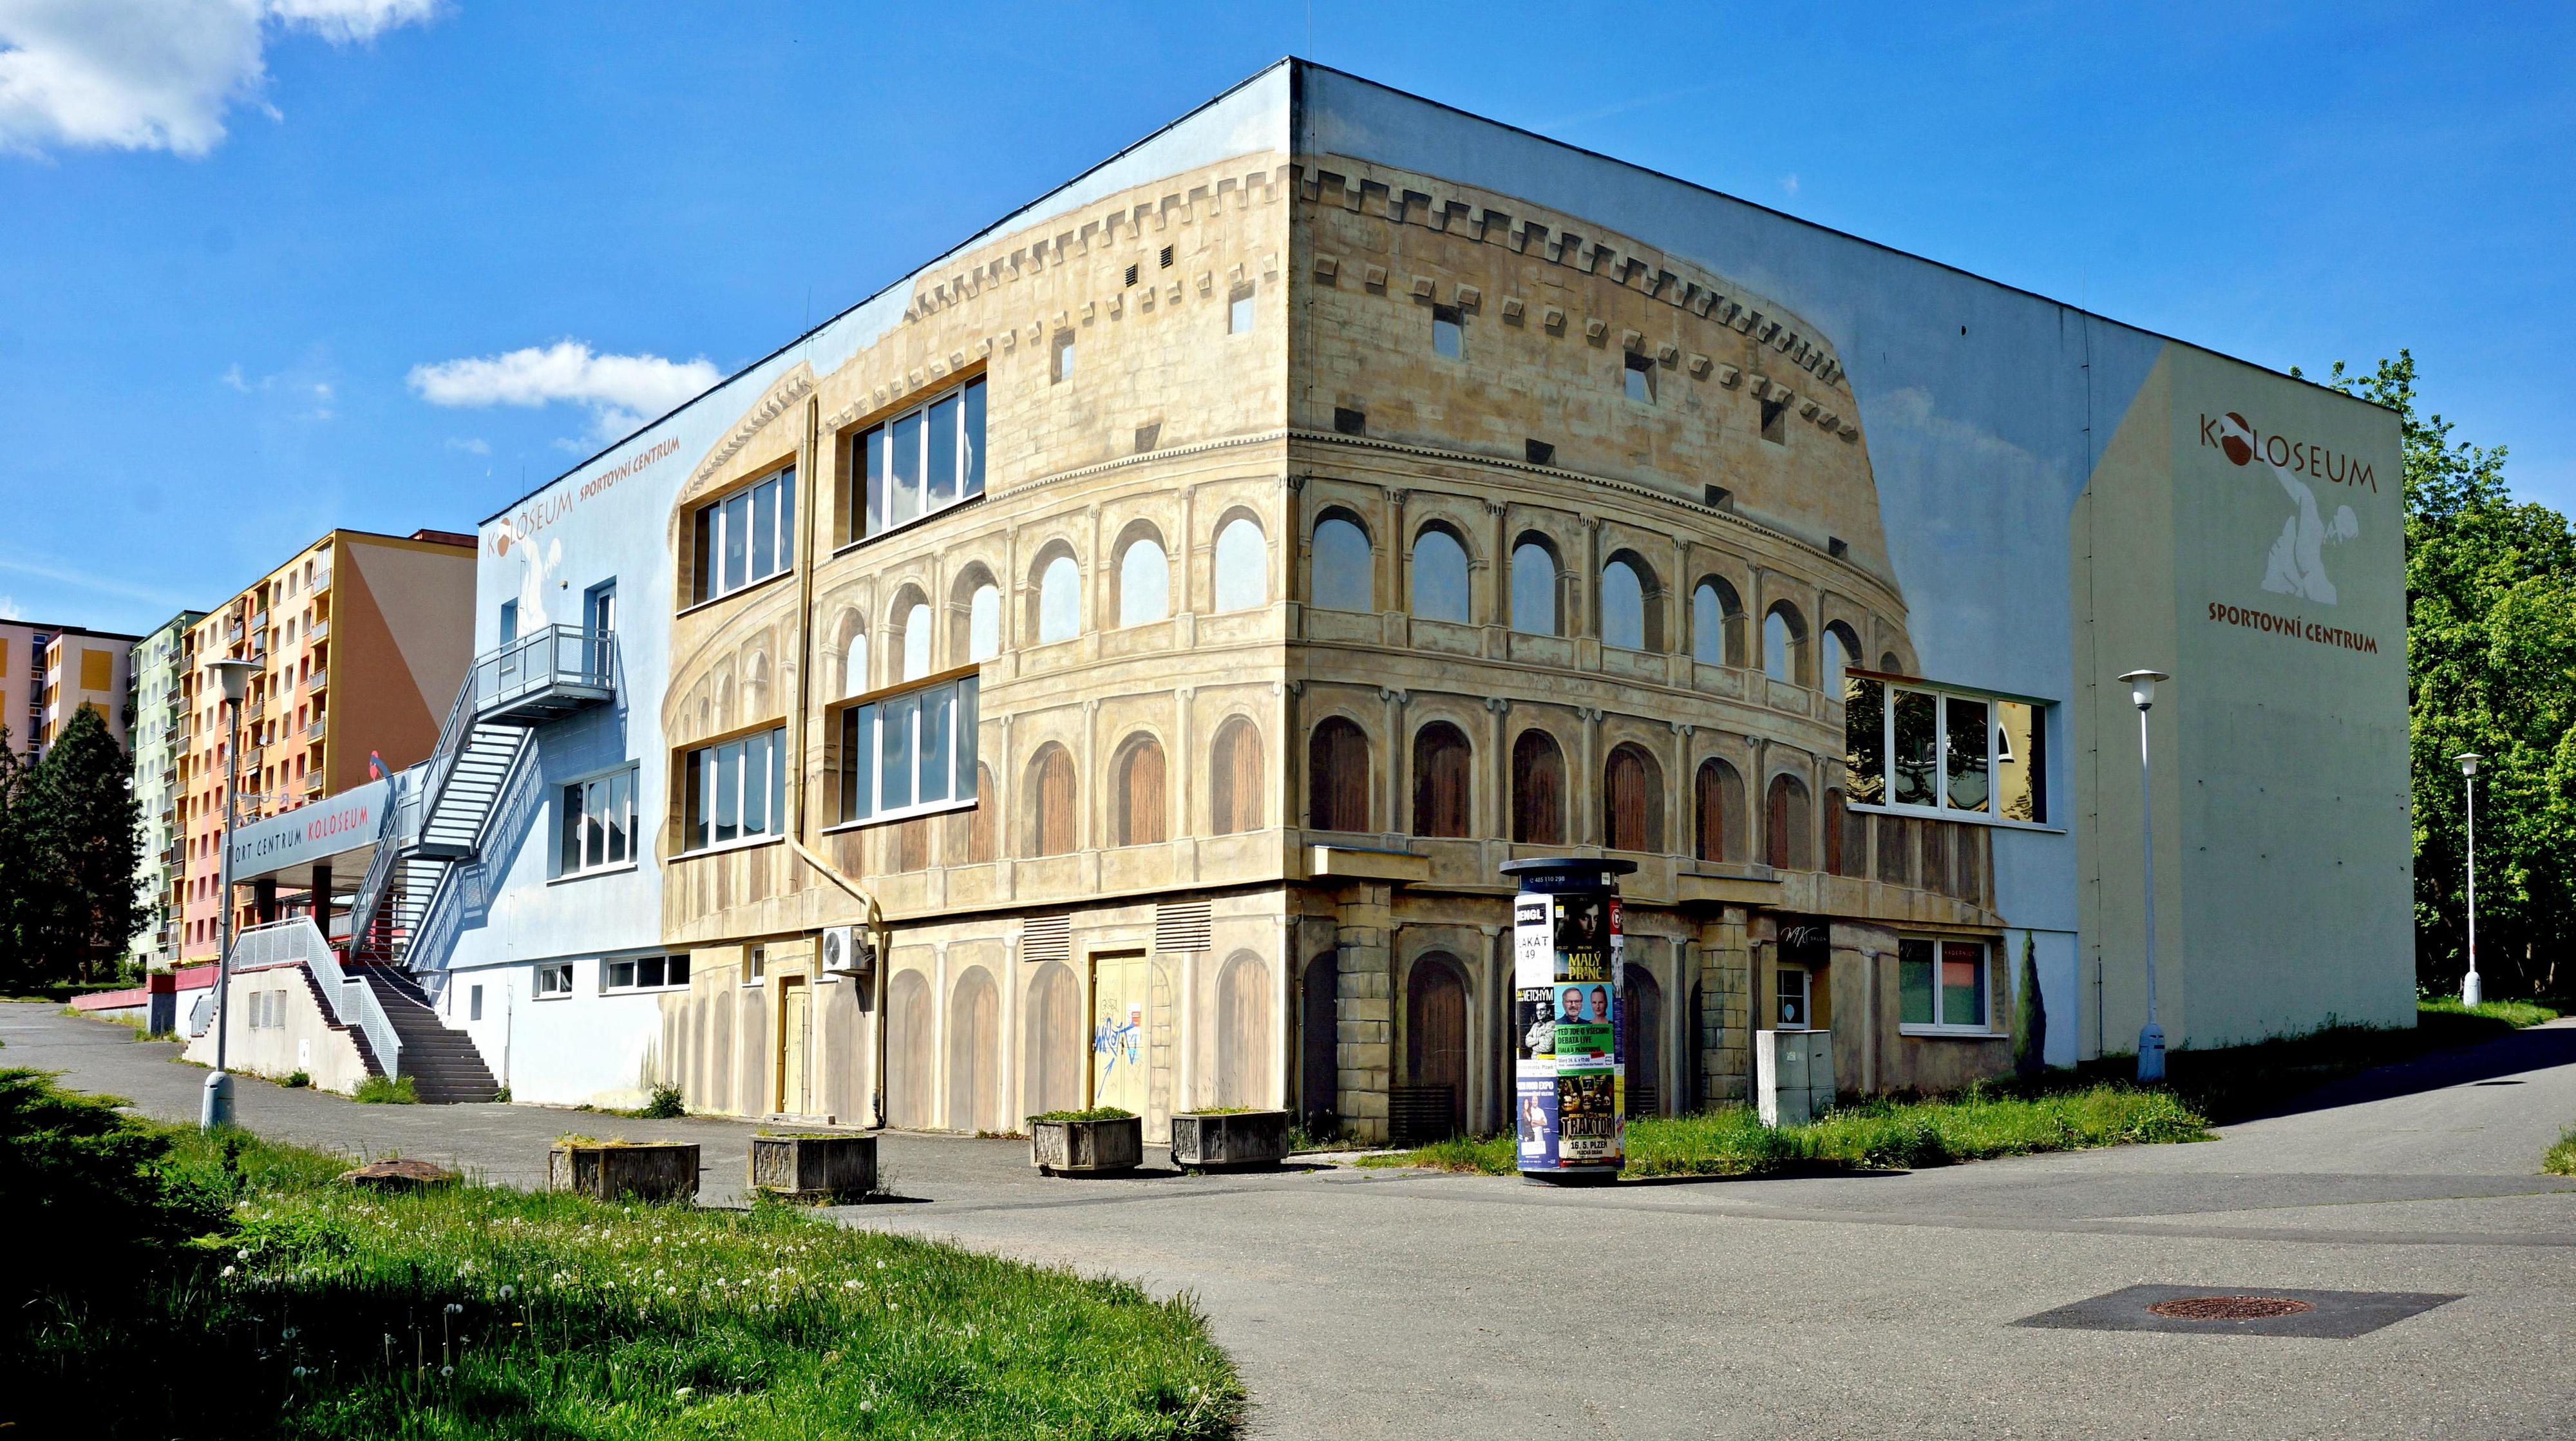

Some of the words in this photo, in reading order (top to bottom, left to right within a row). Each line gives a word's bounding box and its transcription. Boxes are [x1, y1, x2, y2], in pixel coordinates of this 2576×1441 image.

[580, 457, 631, 502] SPORTOVNÍ
[632, 435, 680, 473] CENTRUM
[2200, 412, 2377, 493] KOLOSEUM
[487, 490, 573, 558] KOLOSEUM
[2208, 602, 2301, 638] SPORTOVNÍ
[2305, 622, 2378, 654] CENTRUM
[235, 843, 252, 863] ORT
[257, 828, 301, 857] CENTRUM
[308, 806, 368, 841] KOLOSEUM
[1569, 951, 1601, 966] MALÝ
[1569, 966, 1602, 980] PRINC
[1523, 987, 1553, 1001] VETCHÝM
[1561, 1117, 1613, 1141] TRAKTOR
[1590, 1139, 1607, 1149] PLZEŇ
